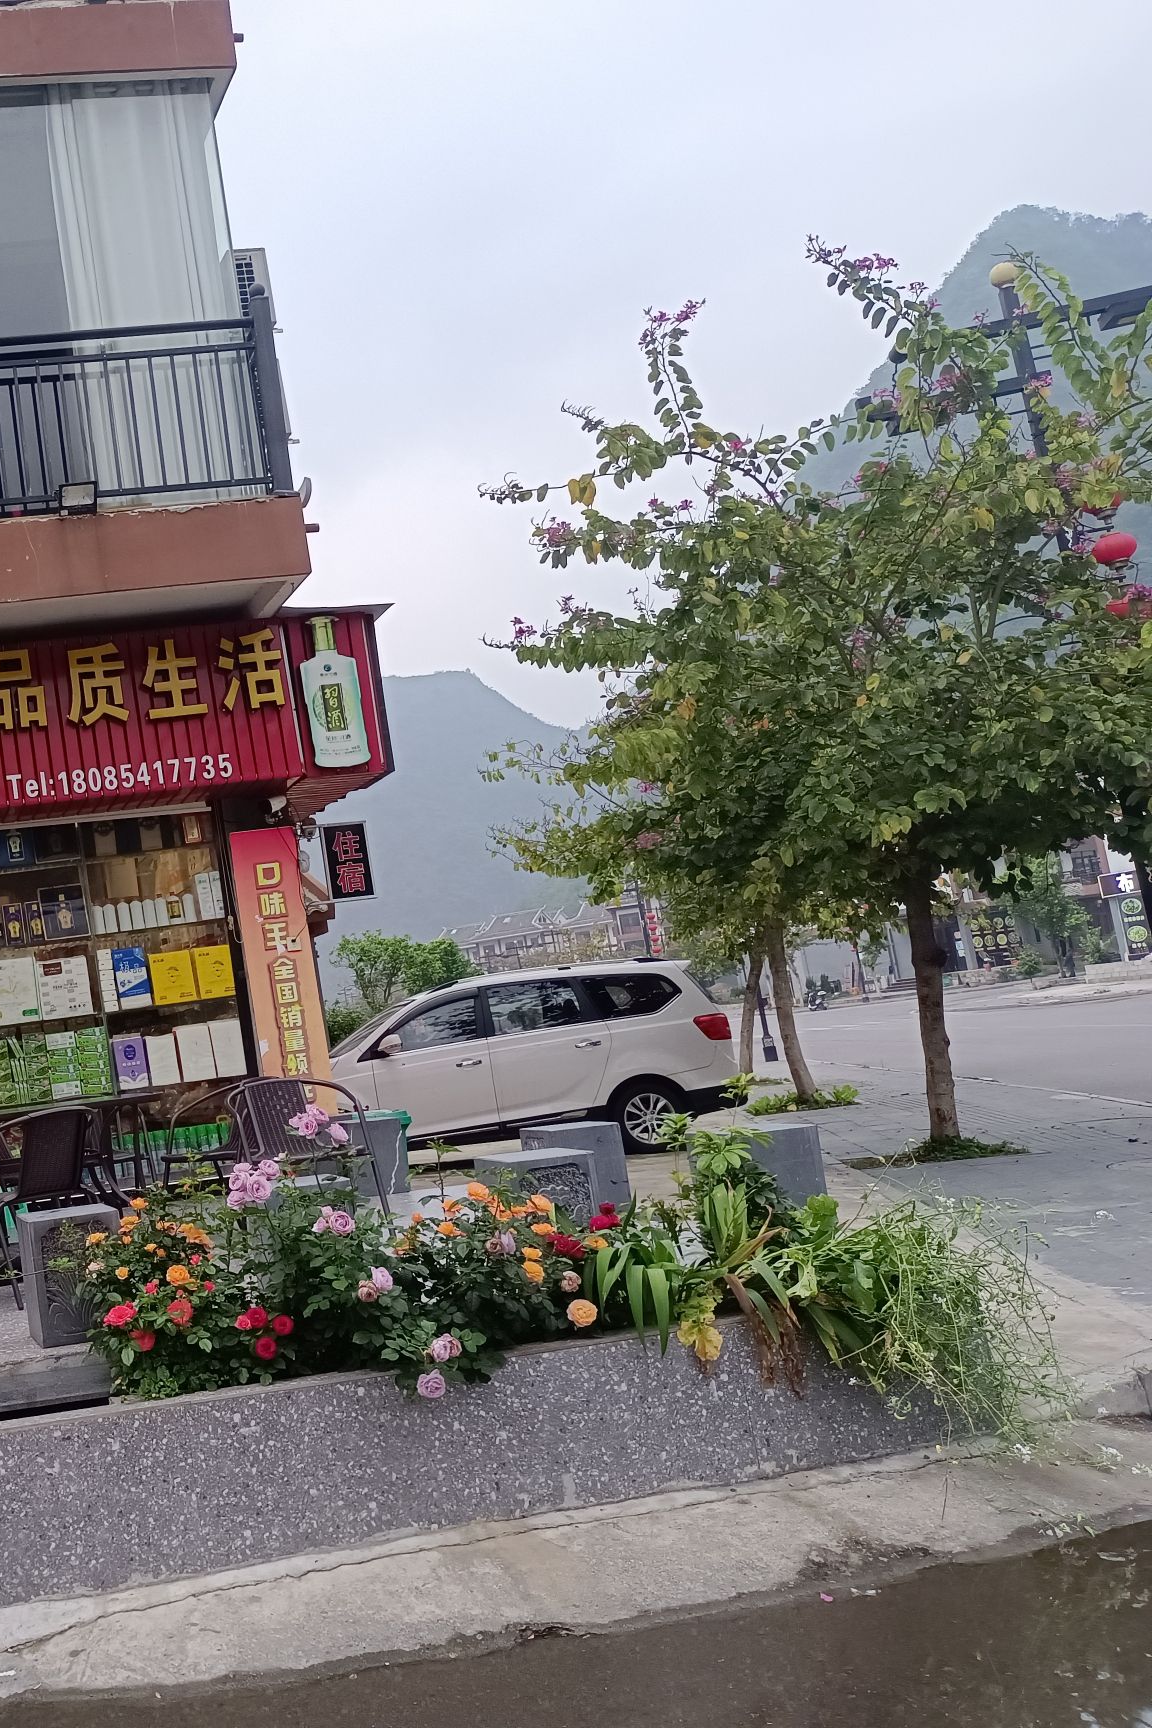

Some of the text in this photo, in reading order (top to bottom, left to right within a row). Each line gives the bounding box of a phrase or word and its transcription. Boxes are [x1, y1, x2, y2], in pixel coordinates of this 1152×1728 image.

[6, 753, 234, 801] Tel:18085417735
[332, 831, 367, 893] 住宿
[1116, 873, 1135, 893] 布
[255, 861, 315, 1101] 口味王 全国销量领
